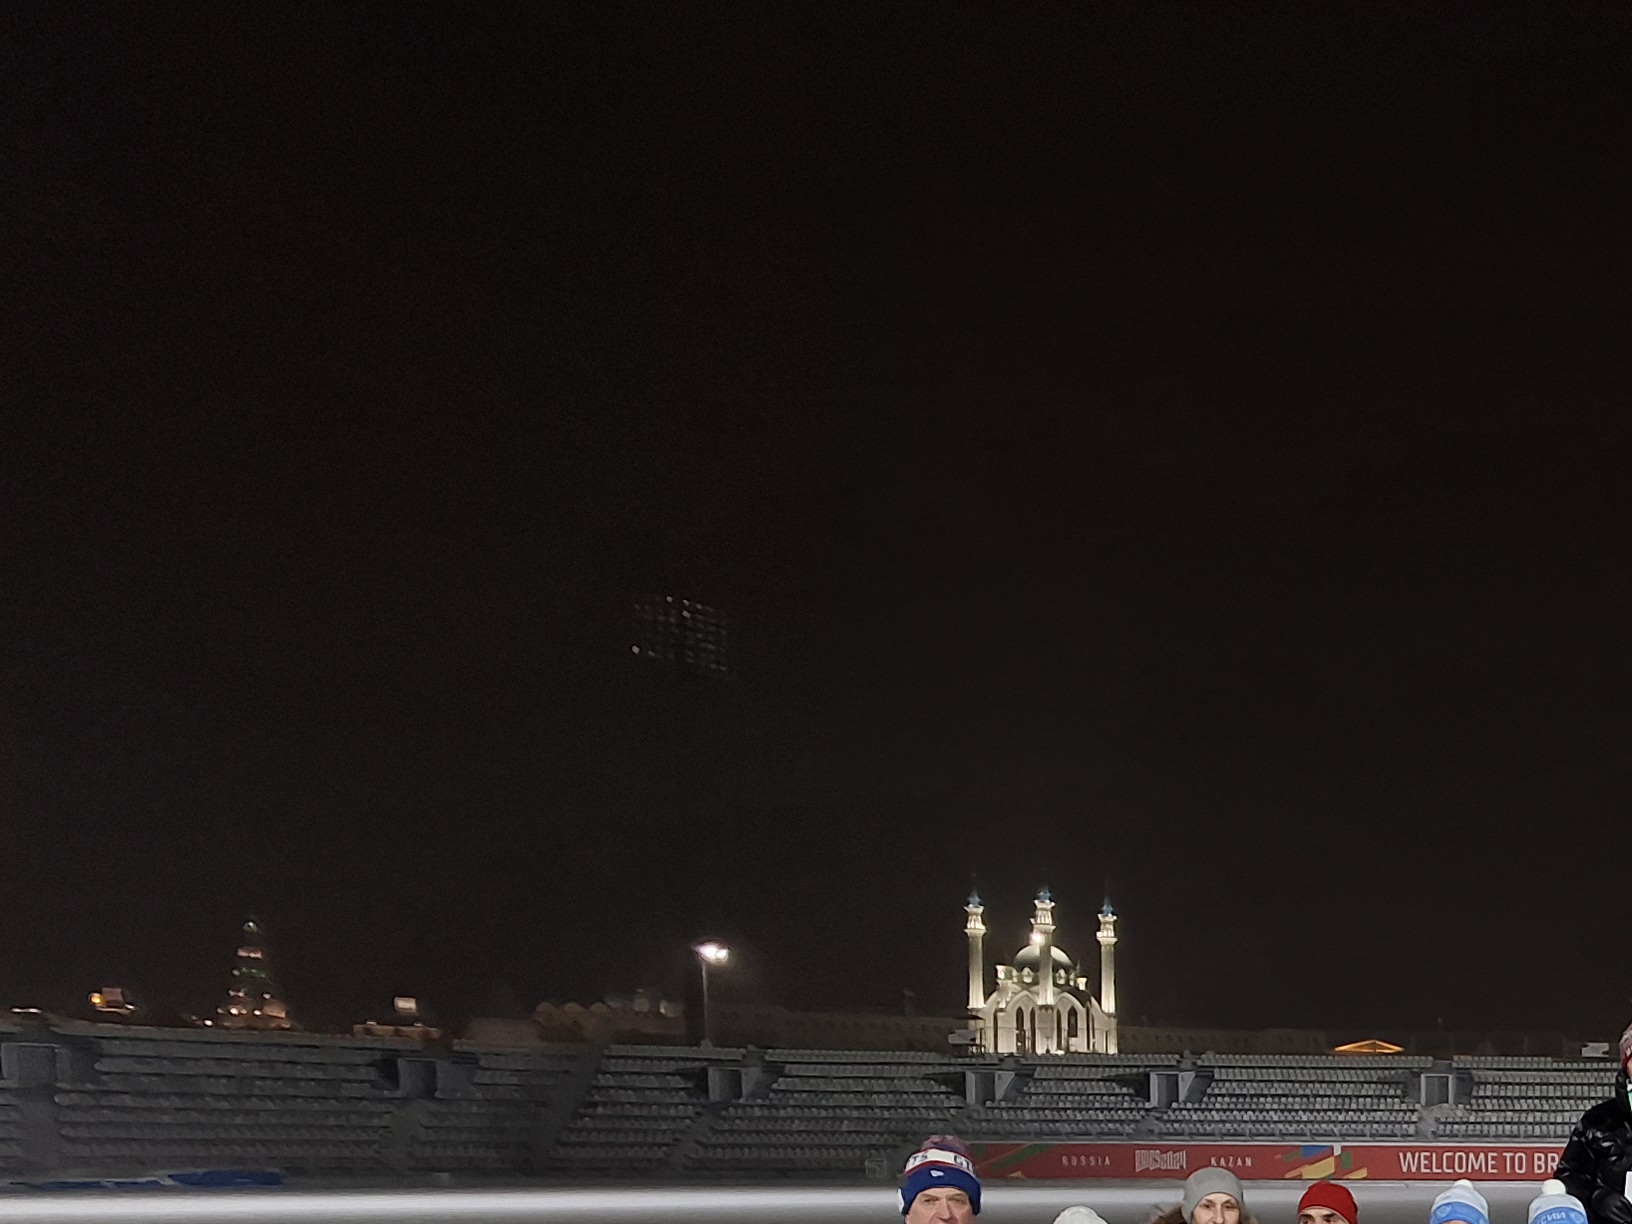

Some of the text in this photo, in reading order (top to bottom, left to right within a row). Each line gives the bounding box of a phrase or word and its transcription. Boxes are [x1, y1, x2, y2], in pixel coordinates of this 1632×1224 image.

[1062, 1155, 1111, 1166] RUSSIA
[1210, 1156, 1252, 1167] KAZAN
[1398, 1152, 1560, 1174] WELCOME TO BR
